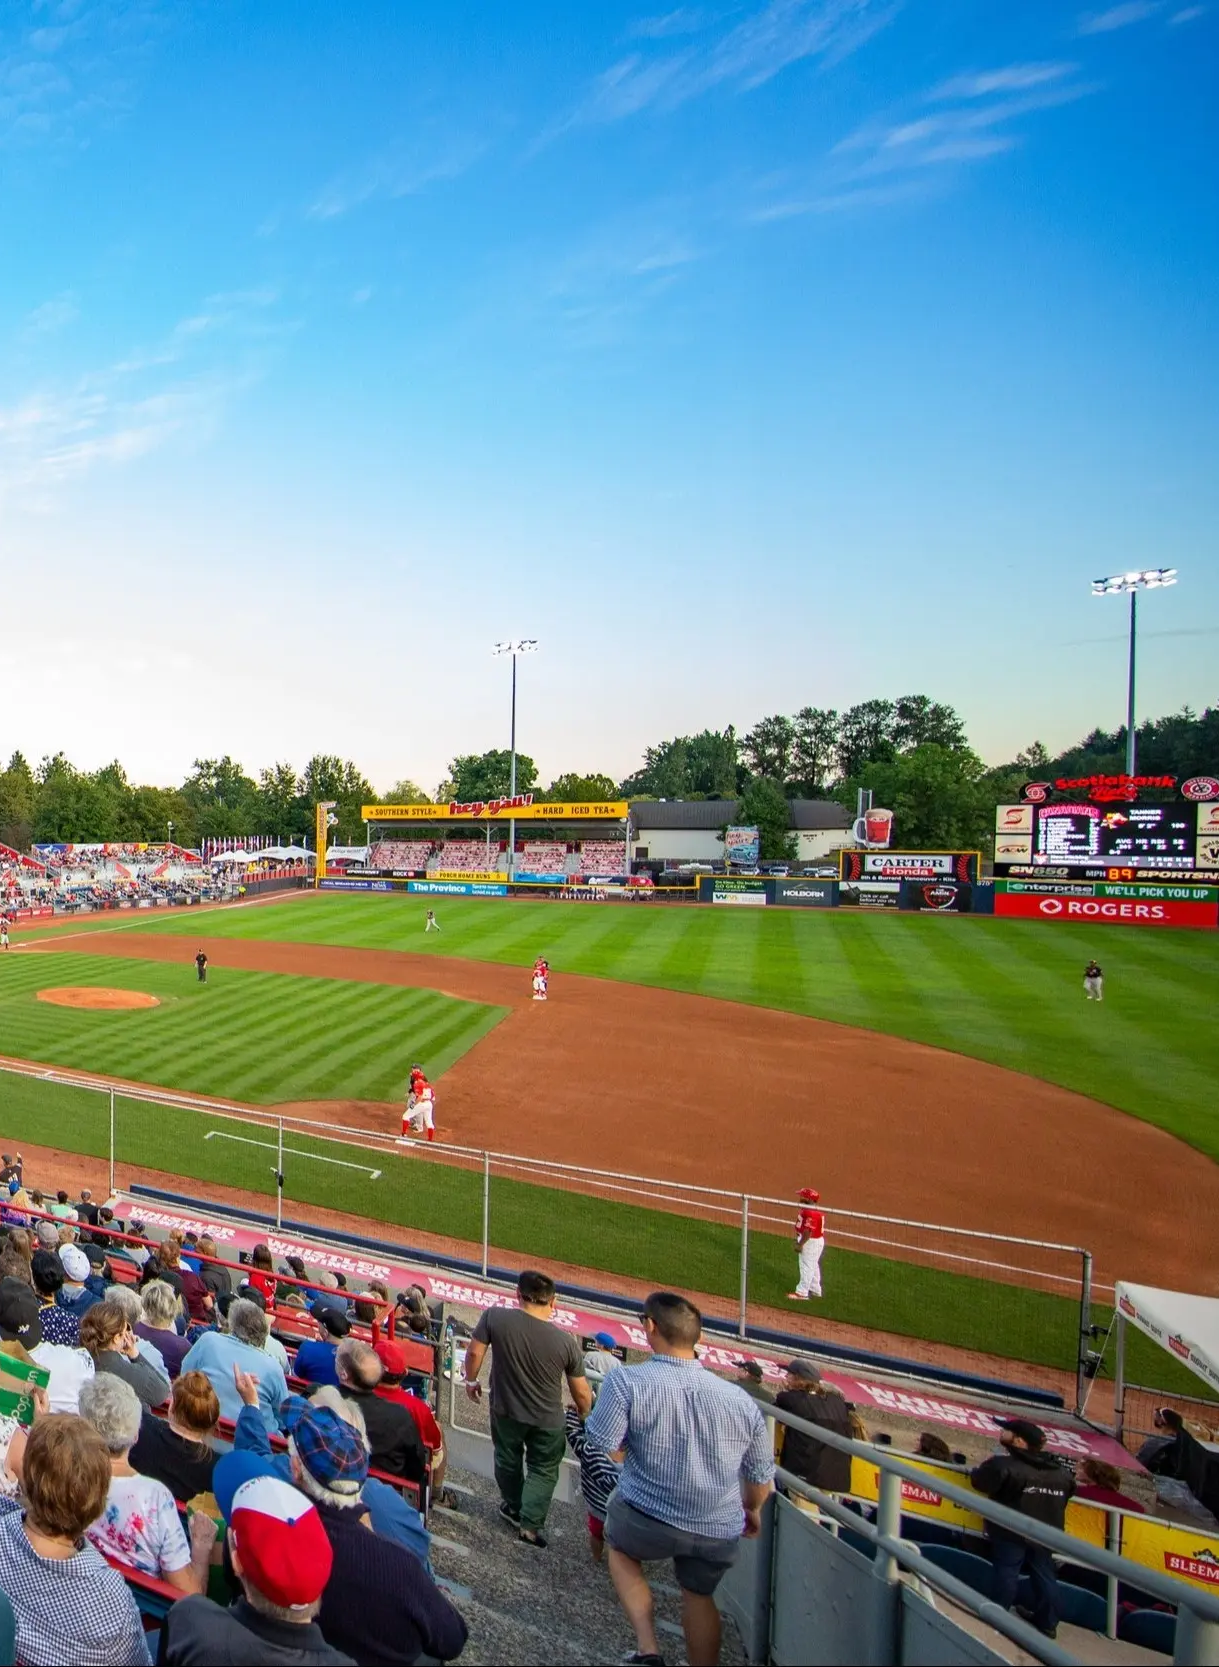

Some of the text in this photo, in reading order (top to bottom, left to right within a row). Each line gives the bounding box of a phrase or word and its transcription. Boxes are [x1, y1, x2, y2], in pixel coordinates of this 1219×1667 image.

[1055, 774, 1175, 790] Scotiabank
[449, 794, 533, 817] hey y'all!
[543, 806, 610, 815] HARD ICED TEA
[412, 808, 432, 816] STYLE
[872, 858, 945, 868] CARTER
[1109, 869, 1132, 880] 89
[413, 883, 466, 893] The Province
[1012, 883, 1093, 892] enterprise
[1105, 886, 1209, 899] WE'LL PICK YOU UP
[782, 889, 825, 898] HOLBORN
[1068, 901, 1164, 919] ROGERS
[129, 1206, 236, 1236] WHISTLER
[267, 1238, 391, 1275] WHISTLER
[901, 1483, 938, 1503] EMAN
[1039, 1487, 1064, 1496] TELUS
